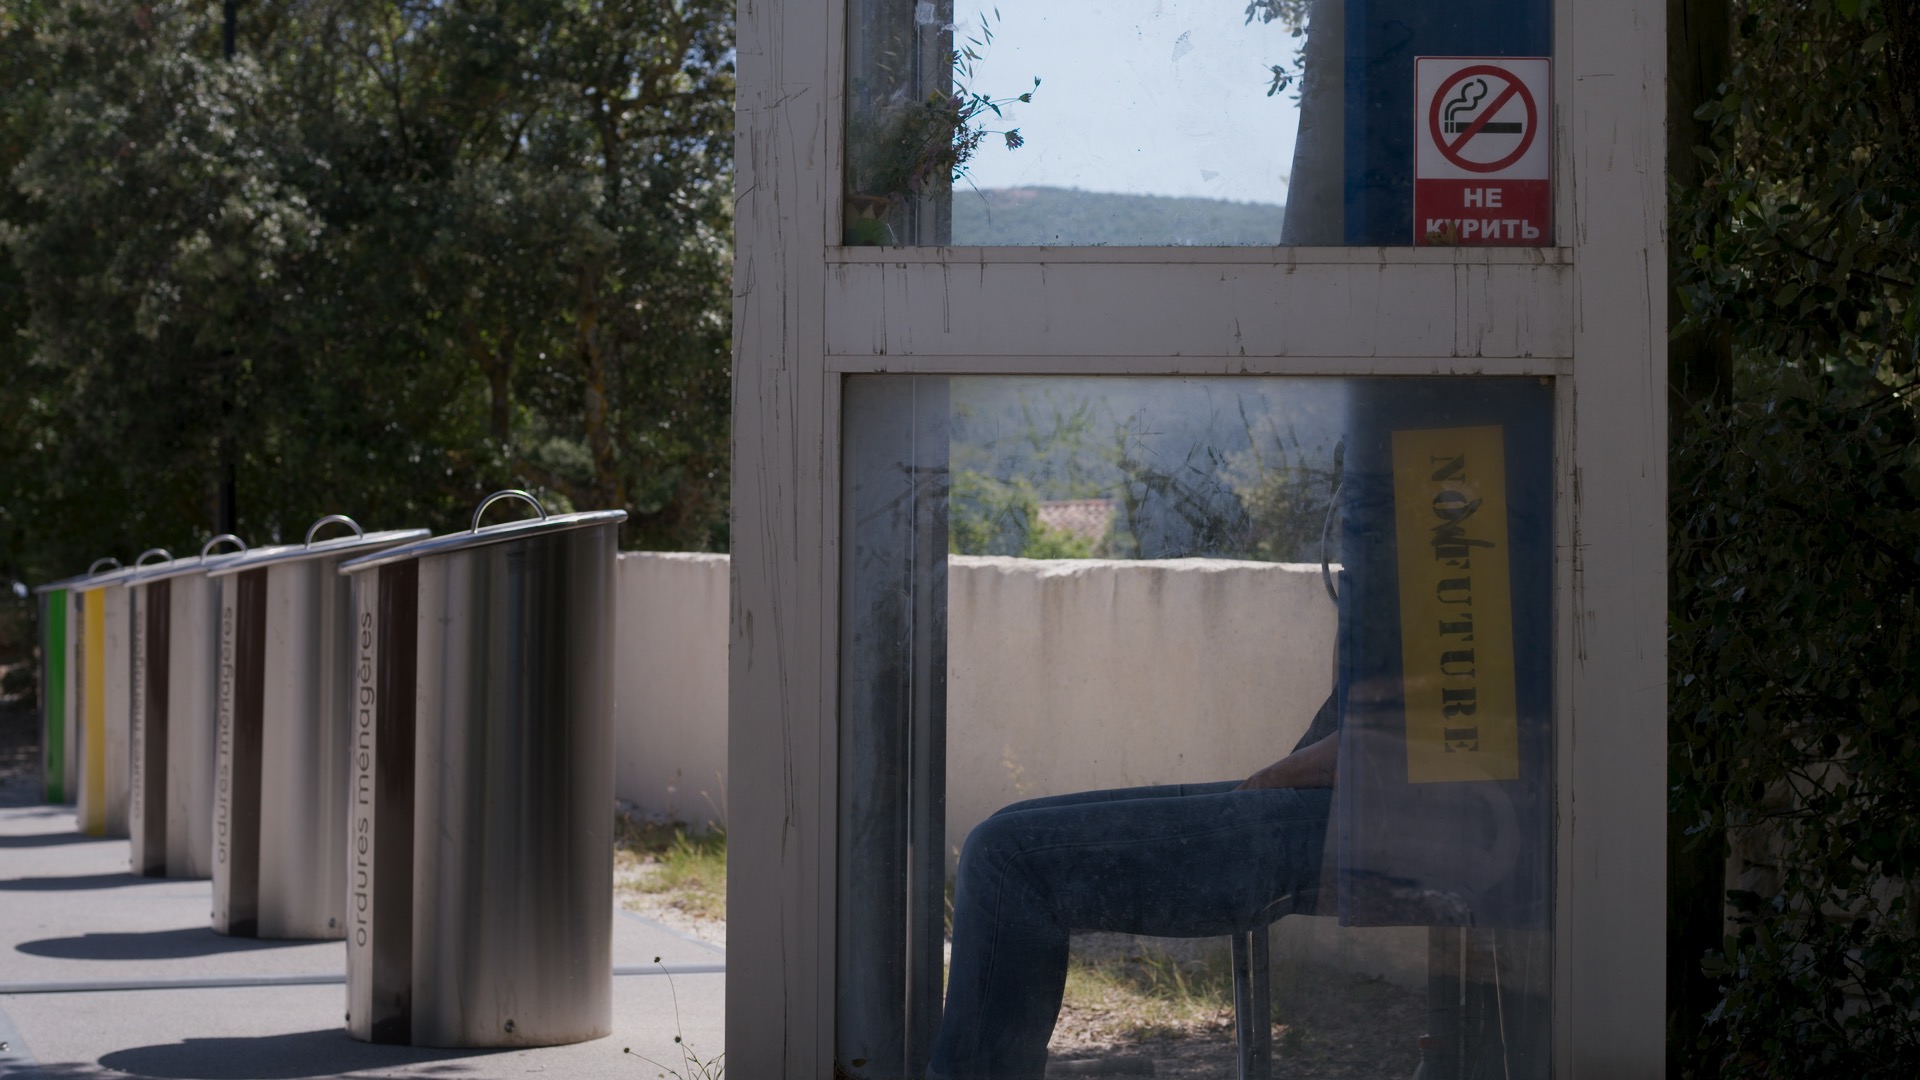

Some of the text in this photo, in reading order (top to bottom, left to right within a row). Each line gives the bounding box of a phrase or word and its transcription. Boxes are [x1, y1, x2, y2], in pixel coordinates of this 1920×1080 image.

[1464, 188, 1502, 208] НЕ
[1434, 545, 1479, 752] FUTURE
[217, 763, 229, 864] ordures
[354, 611, 375, 948] ordures ménagères
